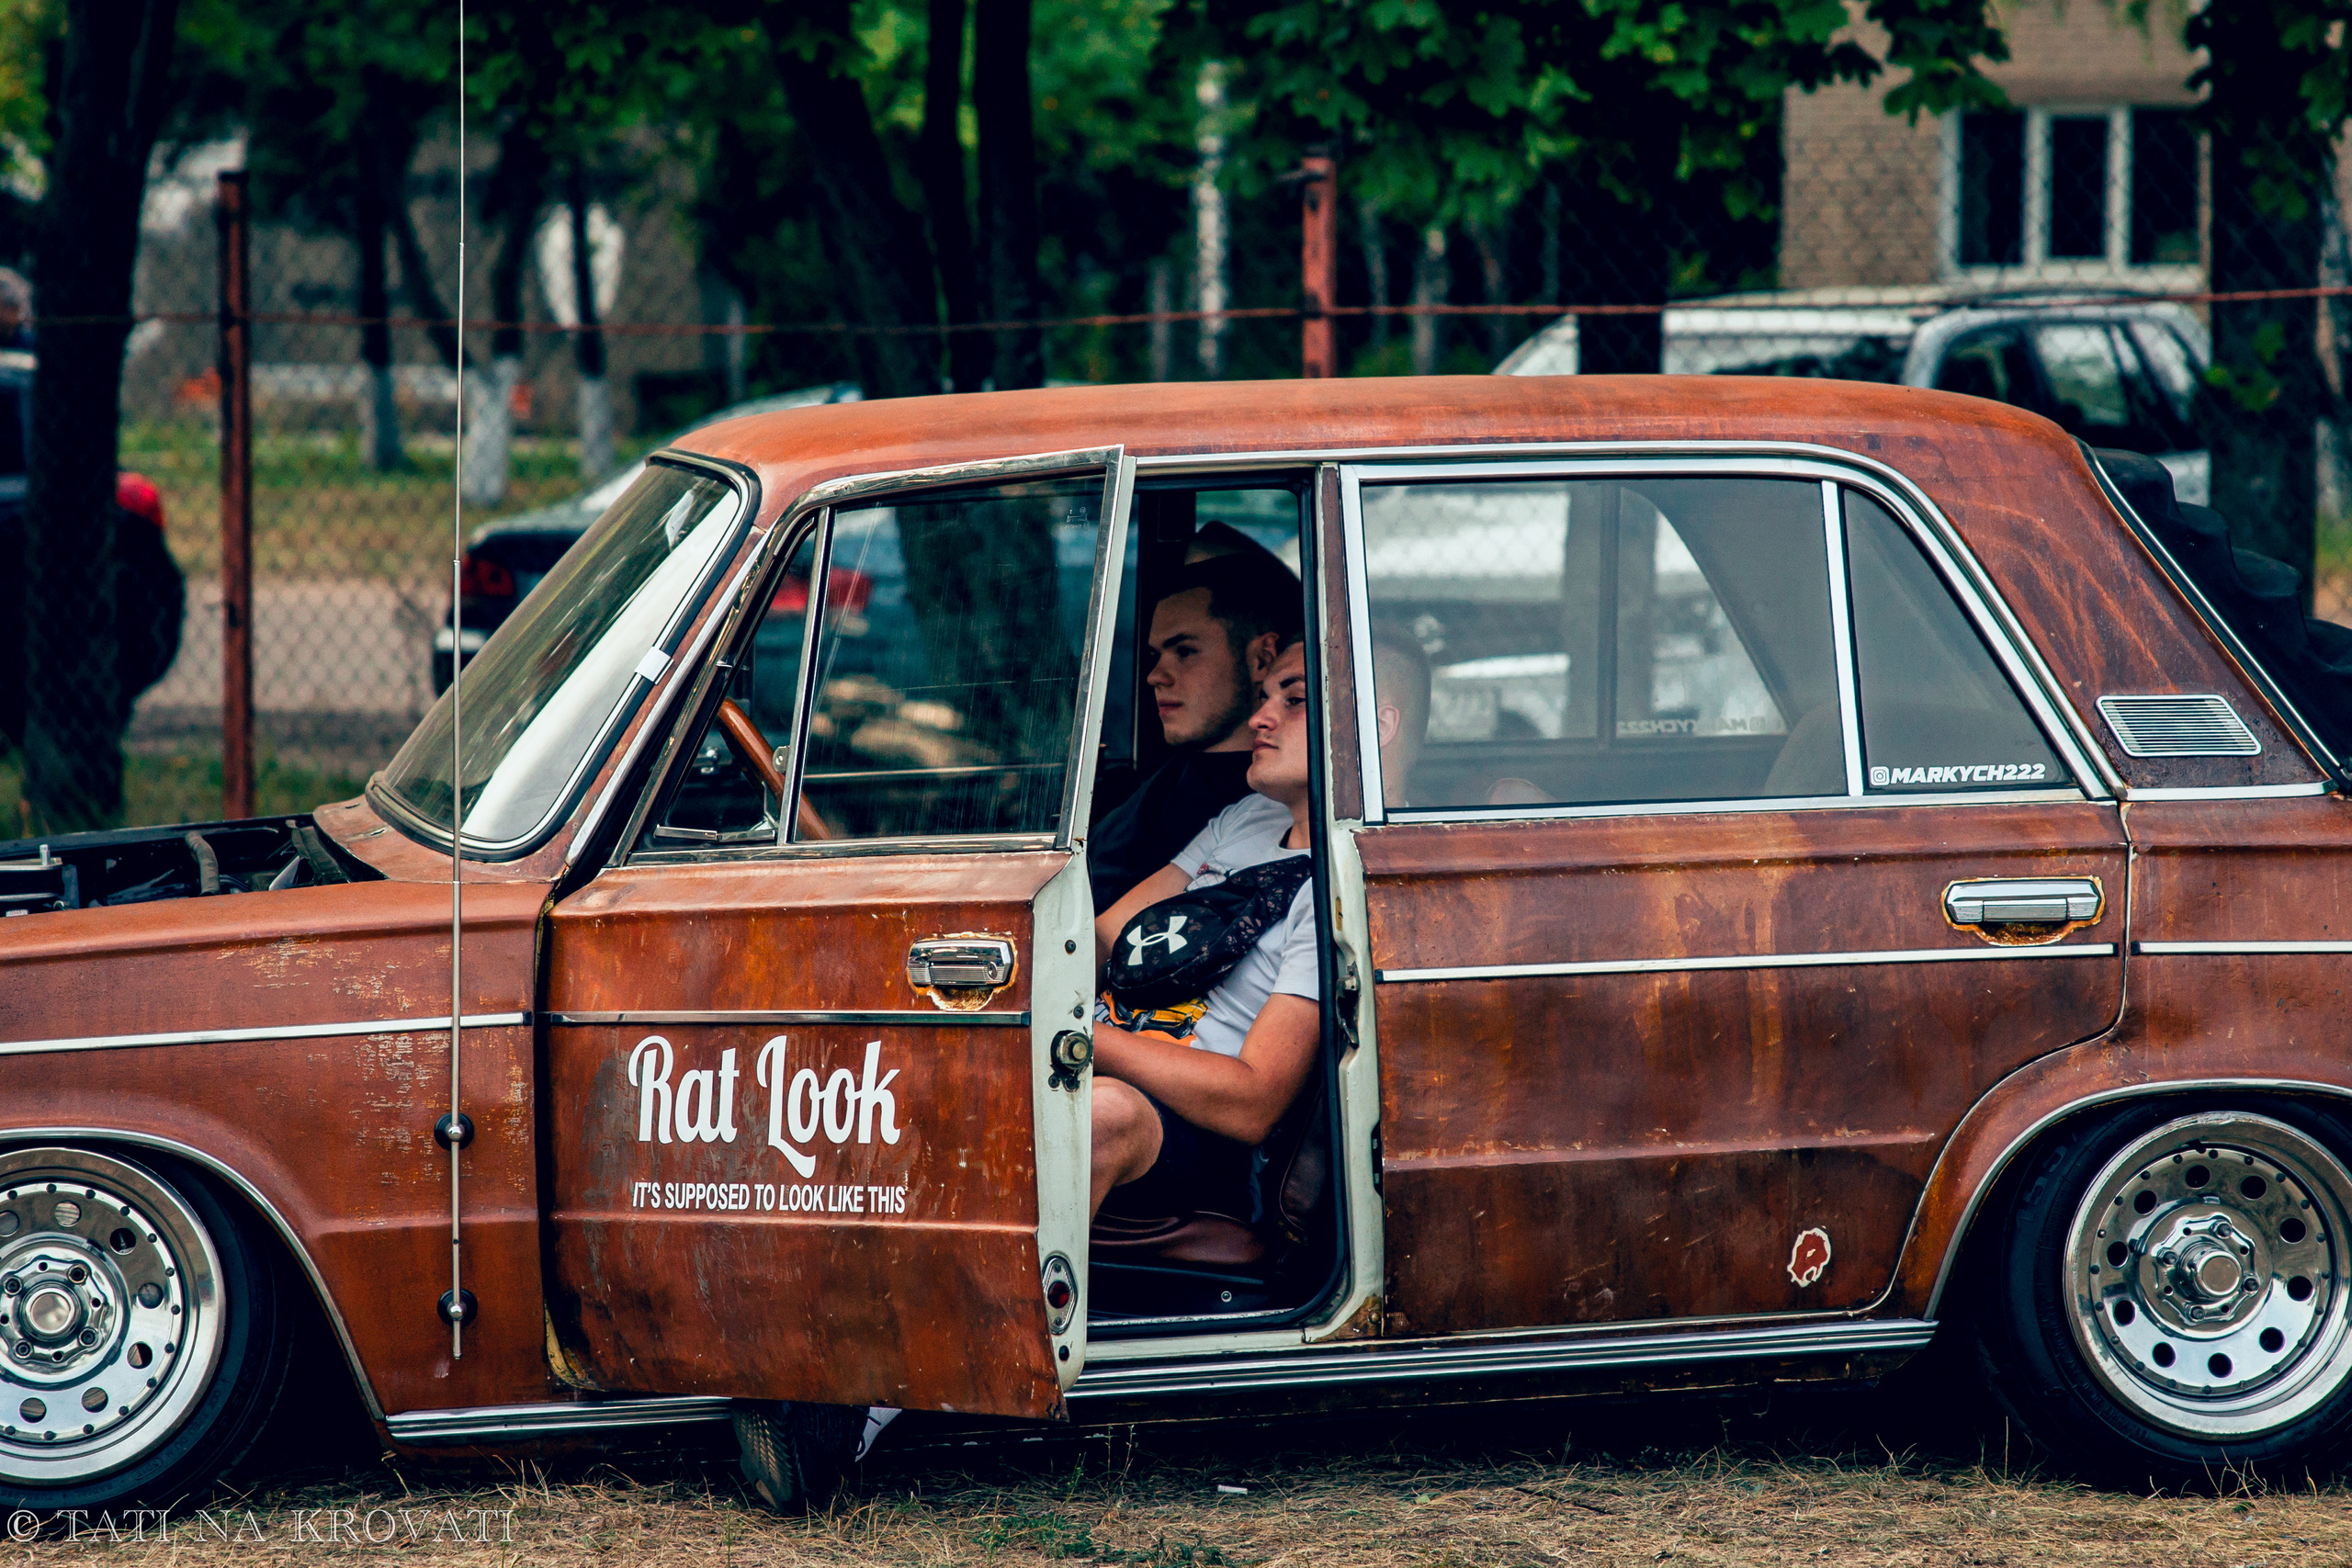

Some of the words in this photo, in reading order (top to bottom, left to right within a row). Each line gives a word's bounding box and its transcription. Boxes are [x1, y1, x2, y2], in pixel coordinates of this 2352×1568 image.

[1890, 763, 2046, 784] MARKYCH222
[628, 1035, 740, 1144] Rat
[756, 1035, 900, 1179] Look
[632, 1182, 661, 1209] IT'S
[664, 1183, 751, 1210] SUPPOSED
[754, 1184, 775, 1211] TO
[781, 1184, 825, 1212] LOOK
[828, 1185, 864, 1213] LIKE
[867, 1186, 906, 1213] THIS
